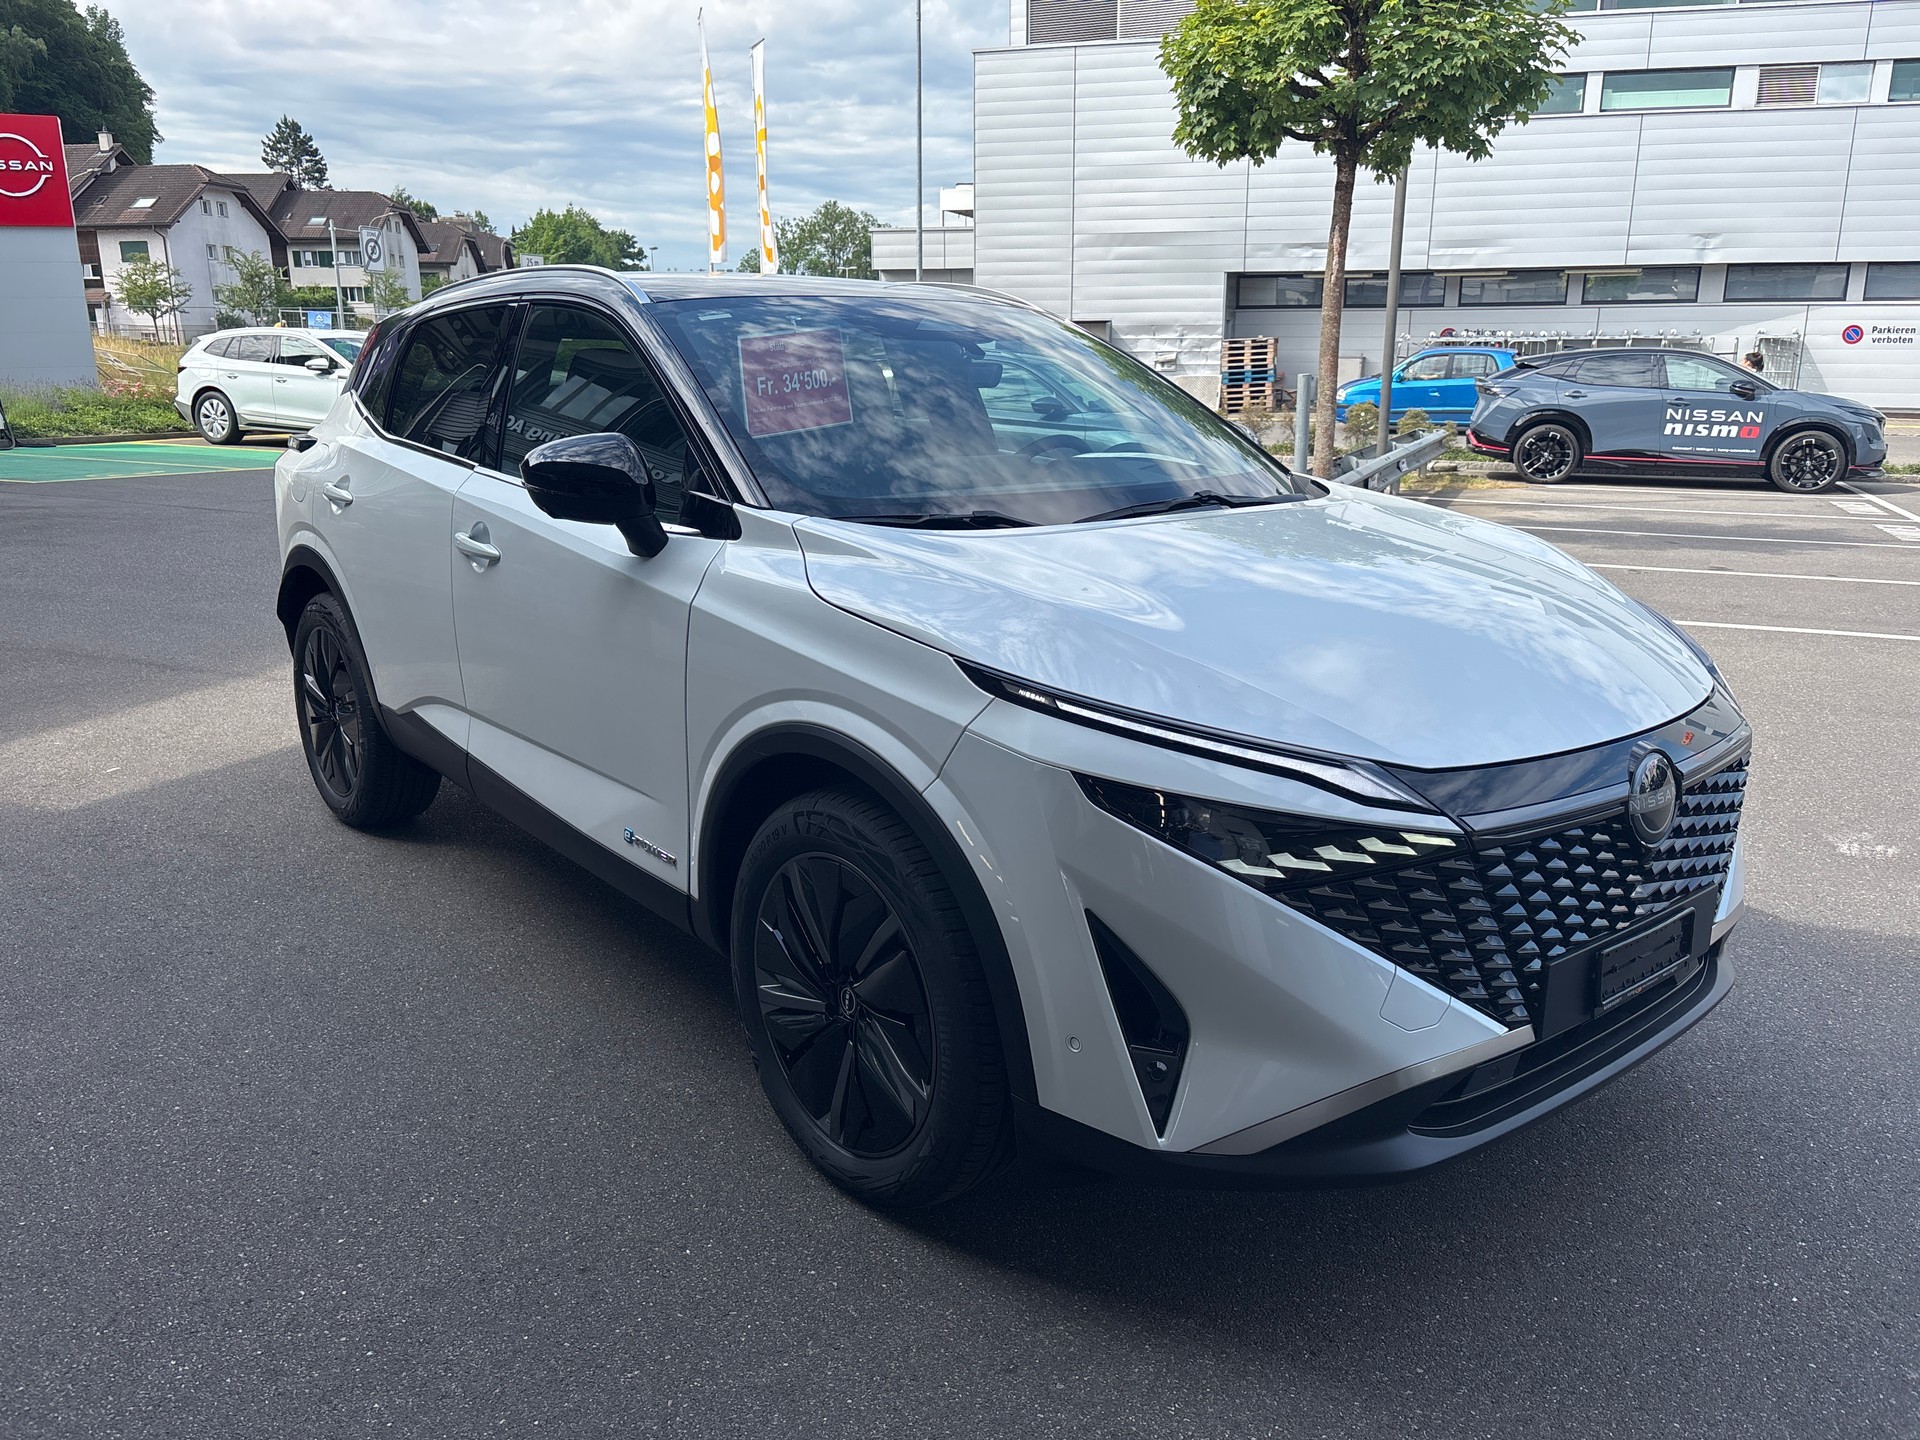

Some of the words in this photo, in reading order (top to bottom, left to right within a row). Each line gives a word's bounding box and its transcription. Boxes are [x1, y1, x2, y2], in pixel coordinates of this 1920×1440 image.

[1872, 326, 1917, 334] Parkieren
[769, 341, 785, 352] statt
[1872, 336, 1914, 344] verboten
[757, 376, 778, 396] Fr.
[1666, 408, 1764, 423] NISSAN
[1663, 423, 1760, 439] nismo
[1018, 689, 1046, 703] NISSAN
[1629, 786, 1676, 812] NISSAN
